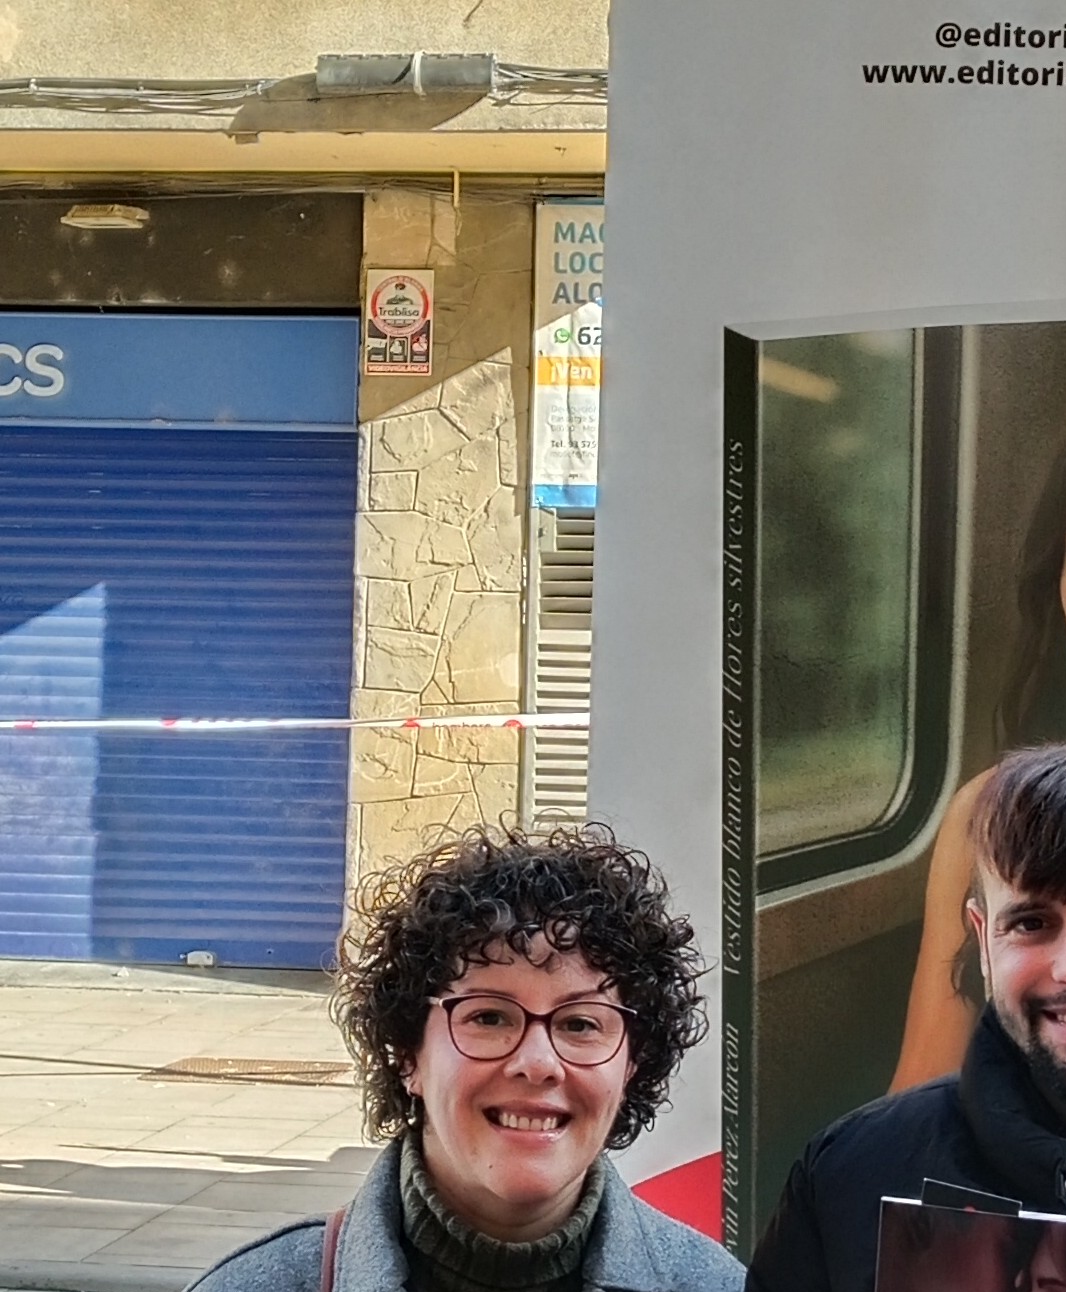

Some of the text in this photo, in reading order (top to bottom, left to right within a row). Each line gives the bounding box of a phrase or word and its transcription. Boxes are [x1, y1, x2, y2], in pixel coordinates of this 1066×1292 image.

[722, 438, 744, 592] silvestres
[721, 601, 743, 703] flores
[722, 708, 743, 748] de
[722, 757, 743, 860] blanco
[722, 868, 743, 977] Vestido
